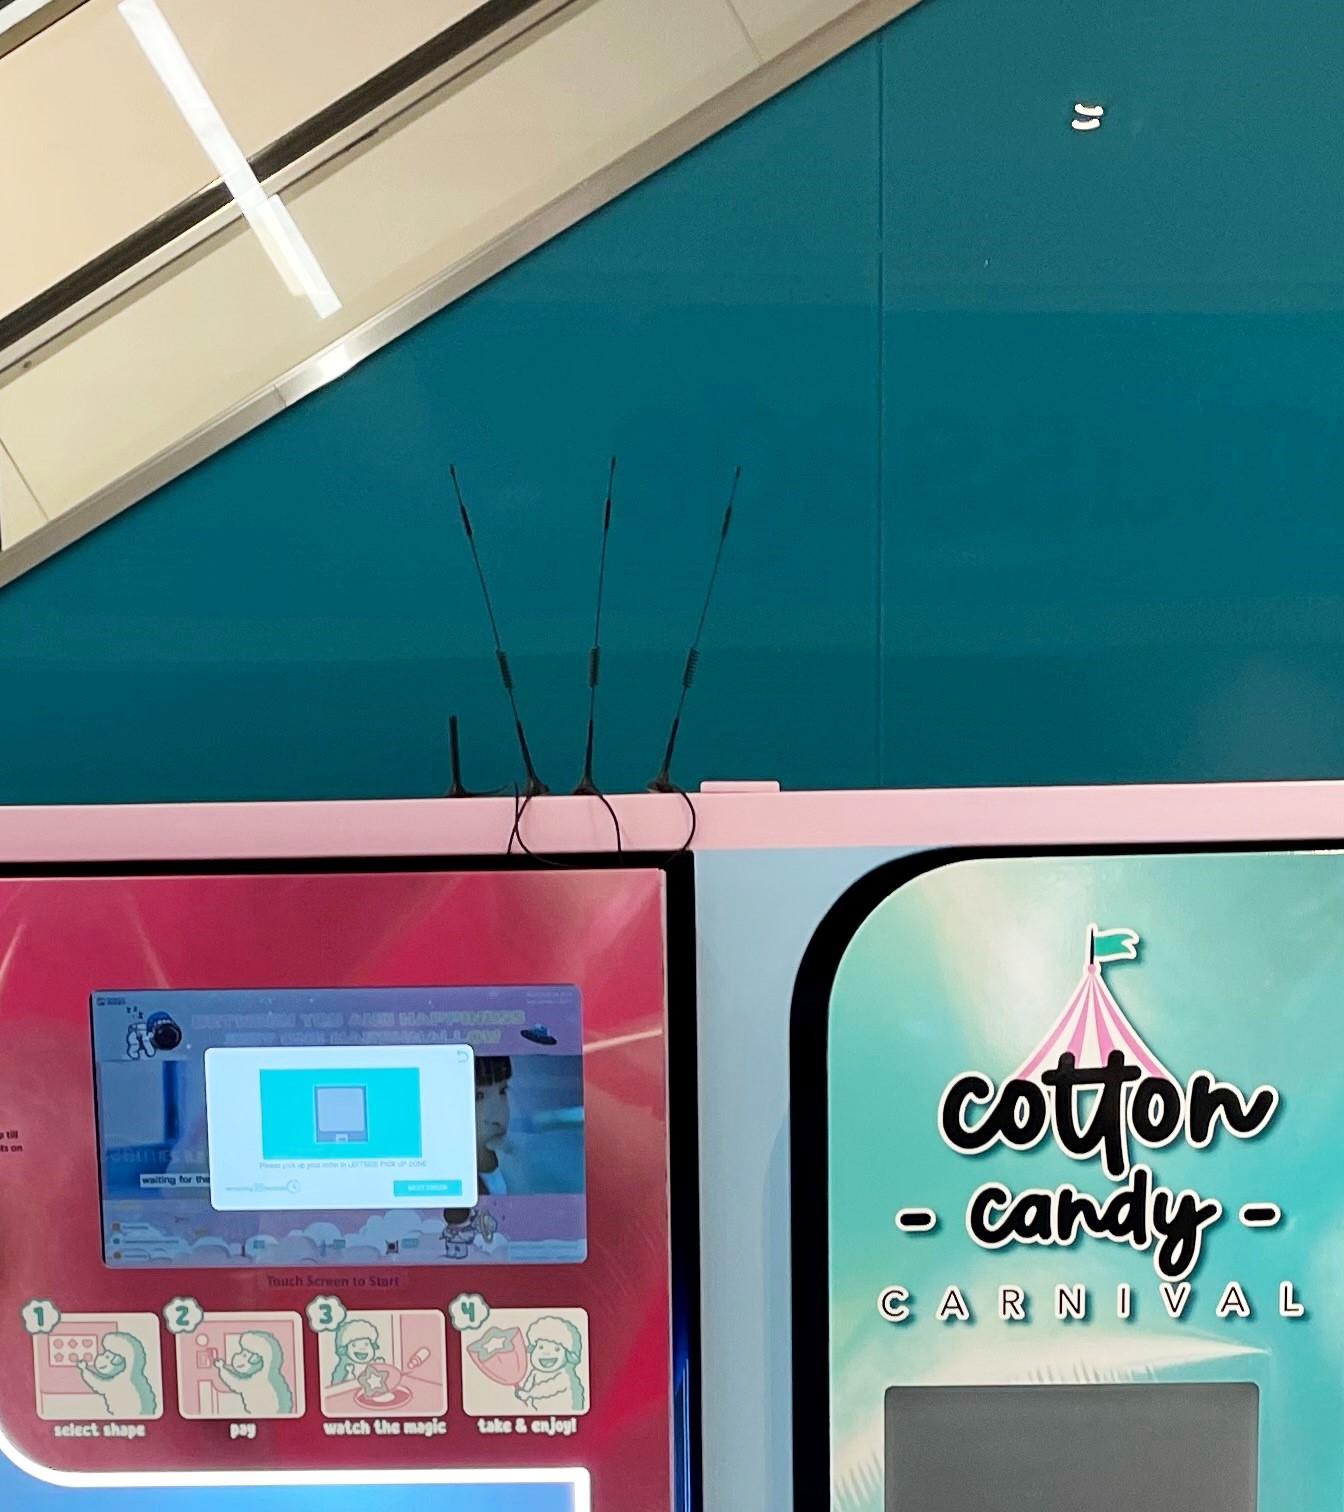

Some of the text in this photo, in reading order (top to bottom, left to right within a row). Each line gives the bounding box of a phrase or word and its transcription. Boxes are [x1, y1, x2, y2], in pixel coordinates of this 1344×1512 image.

[938, 1050, 1278, 1179] cotton
[6, 1130, 19, 1139] till
[11, 1144, 23, 1152] on
[142, 1176, 176, 1185] waiting
[179, 1175, 192, 1183] for
[967, 1164, 1223, 1280] candy
[267, 1275, 399, 1287] Touch Screen to Start
[878, 1281, 1303, 1322] CARNIVAL
[34, 1306, 44, 1327] 1
[176, 1306, 189, 1326] 2
[319, 1304, 332, 1324] 3
[461, 1302, 475, 1322] 4
[54, 1423, 145, 1439] select shape
[230, 1423, 256, 1439] pay
[323, 1418, 447, 1437] watch the magic
[477, 1417, 577, 1436] take & enjoy!
